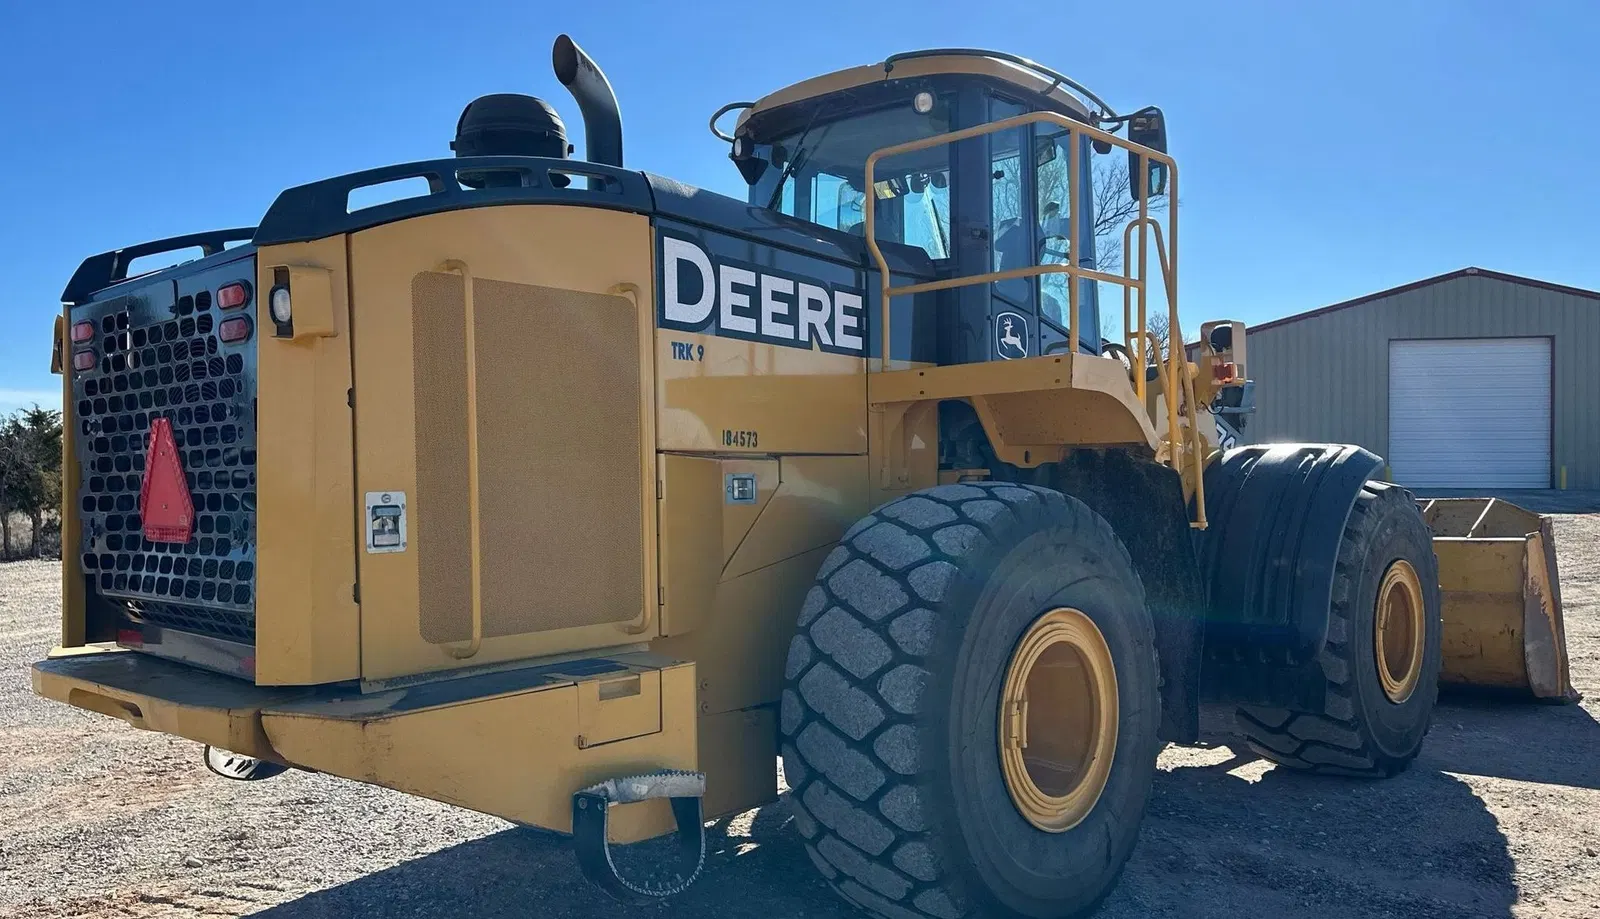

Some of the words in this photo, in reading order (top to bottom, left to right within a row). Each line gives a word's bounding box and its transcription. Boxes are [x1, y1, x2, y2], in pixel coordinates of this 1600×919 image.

[663, 236, 863, 351] DEERE
[671, 341, 694, 361] TRK
[697, 344, 704, 362] 9
[722, 429, 758, 448] 184573
